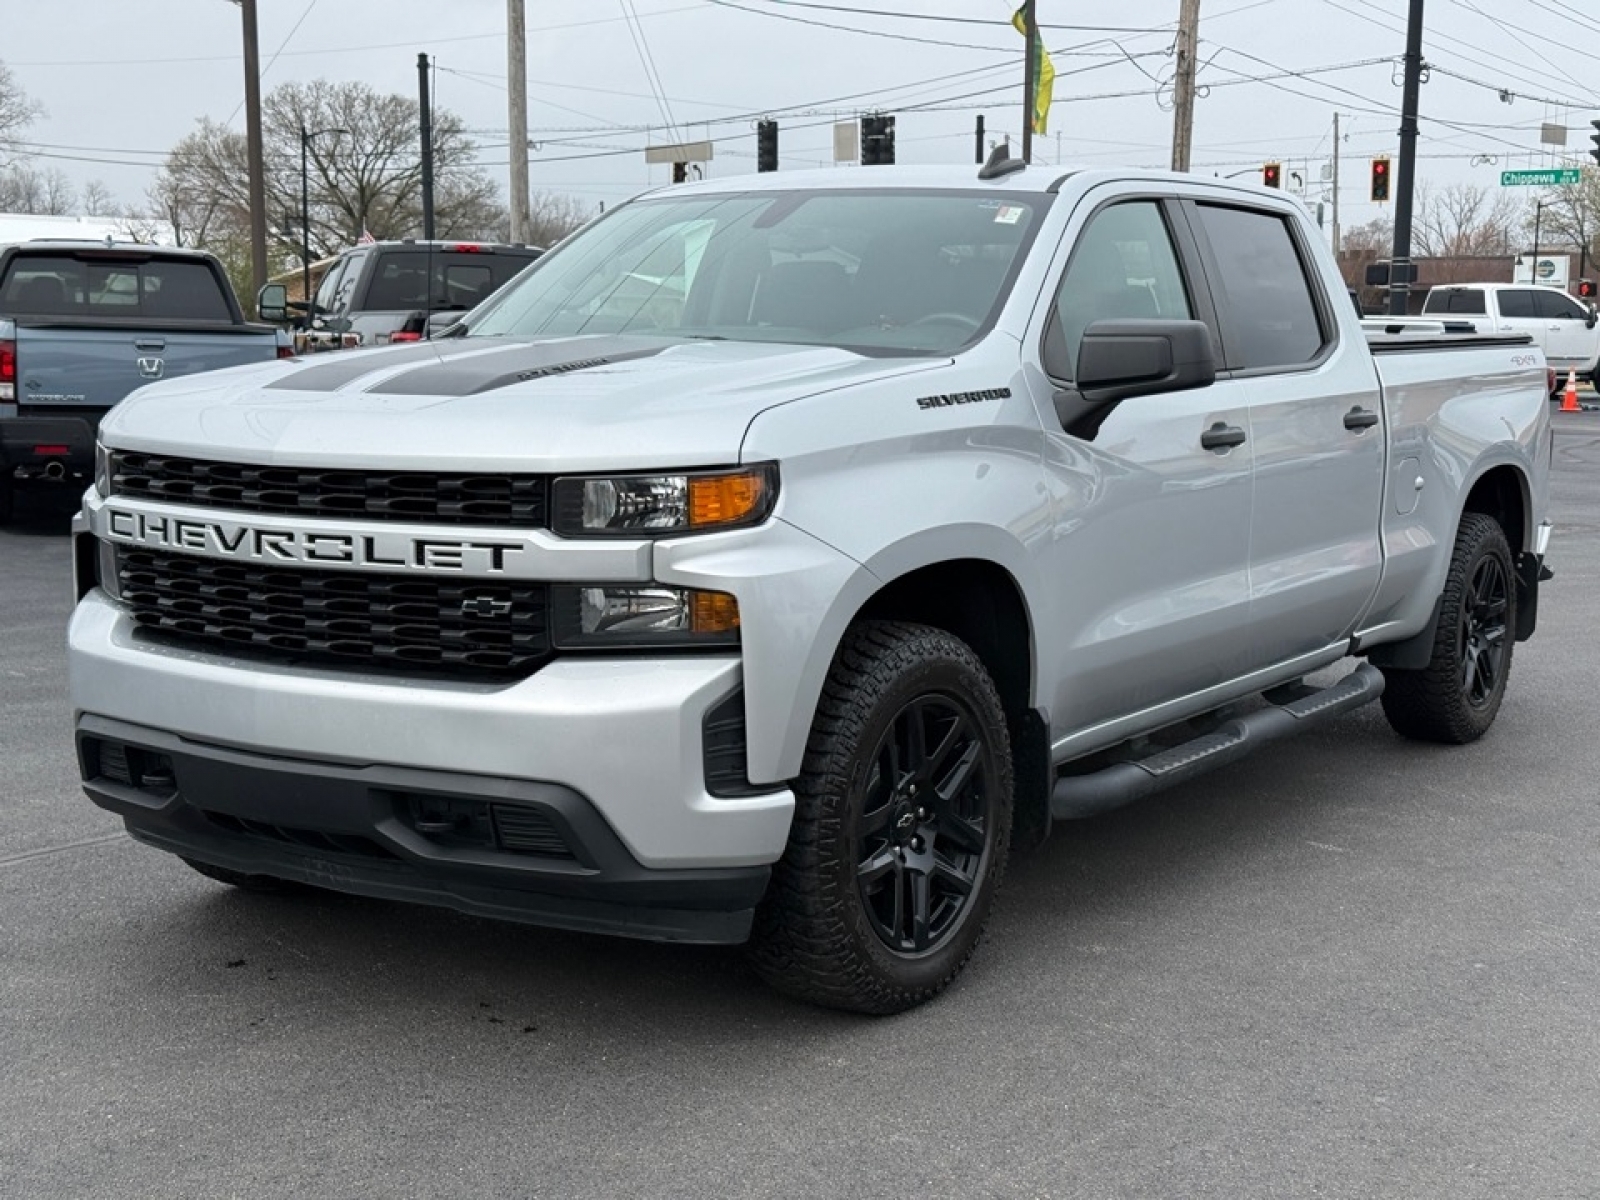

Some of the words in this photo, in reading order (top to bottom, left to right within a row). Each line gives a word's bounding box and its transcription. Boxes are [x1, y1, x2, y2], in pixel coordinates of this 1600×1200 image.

[1503, 172, 1555, 186] Chippewa
[916, 387, 1012, 410] SILVERADO
[107, 509, 524, 572] CHEVROLET
